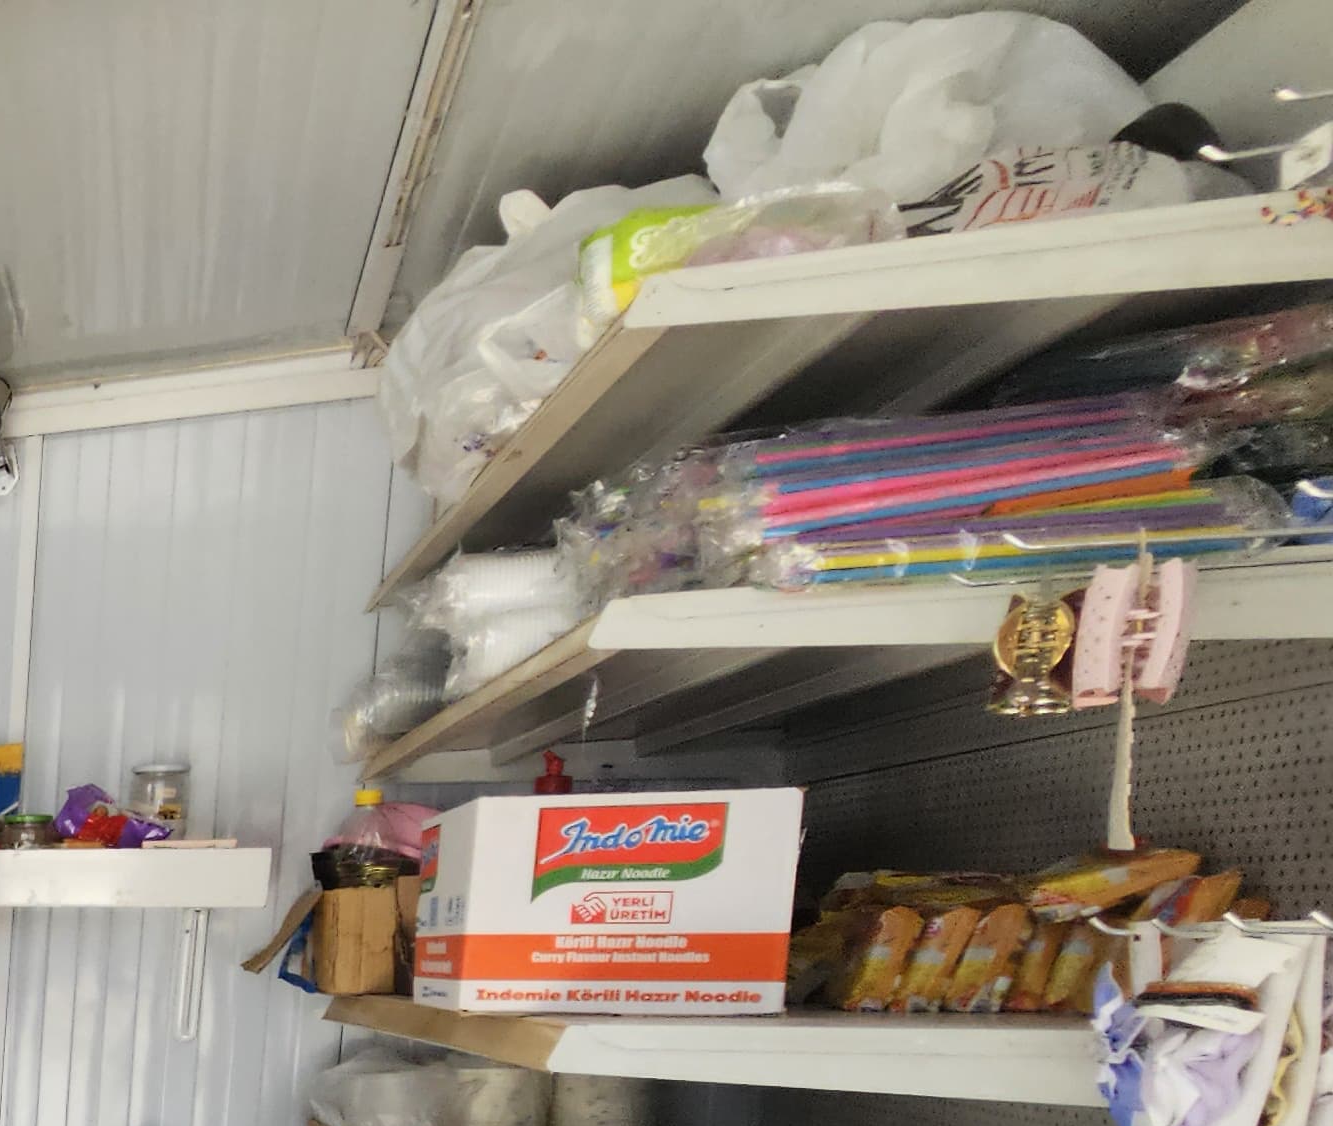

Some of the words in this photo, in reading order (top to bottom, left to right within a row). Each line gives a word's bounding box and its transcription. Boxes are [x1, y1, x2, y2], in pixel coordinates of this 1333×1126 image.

[581, 867, 617, 880] Hazır
[619, 867, 671, 879] Noodle
[612, 895, 654, 907] YERLİ
[609, 907, 667, 921] ÜRETİM
[476, 986, 562, 1002] Indomie
[566, 988, 621, 1002] Körili
[624, 989, 681, 1003] Hazır
[684, 990, 763, 1004] Noodle
